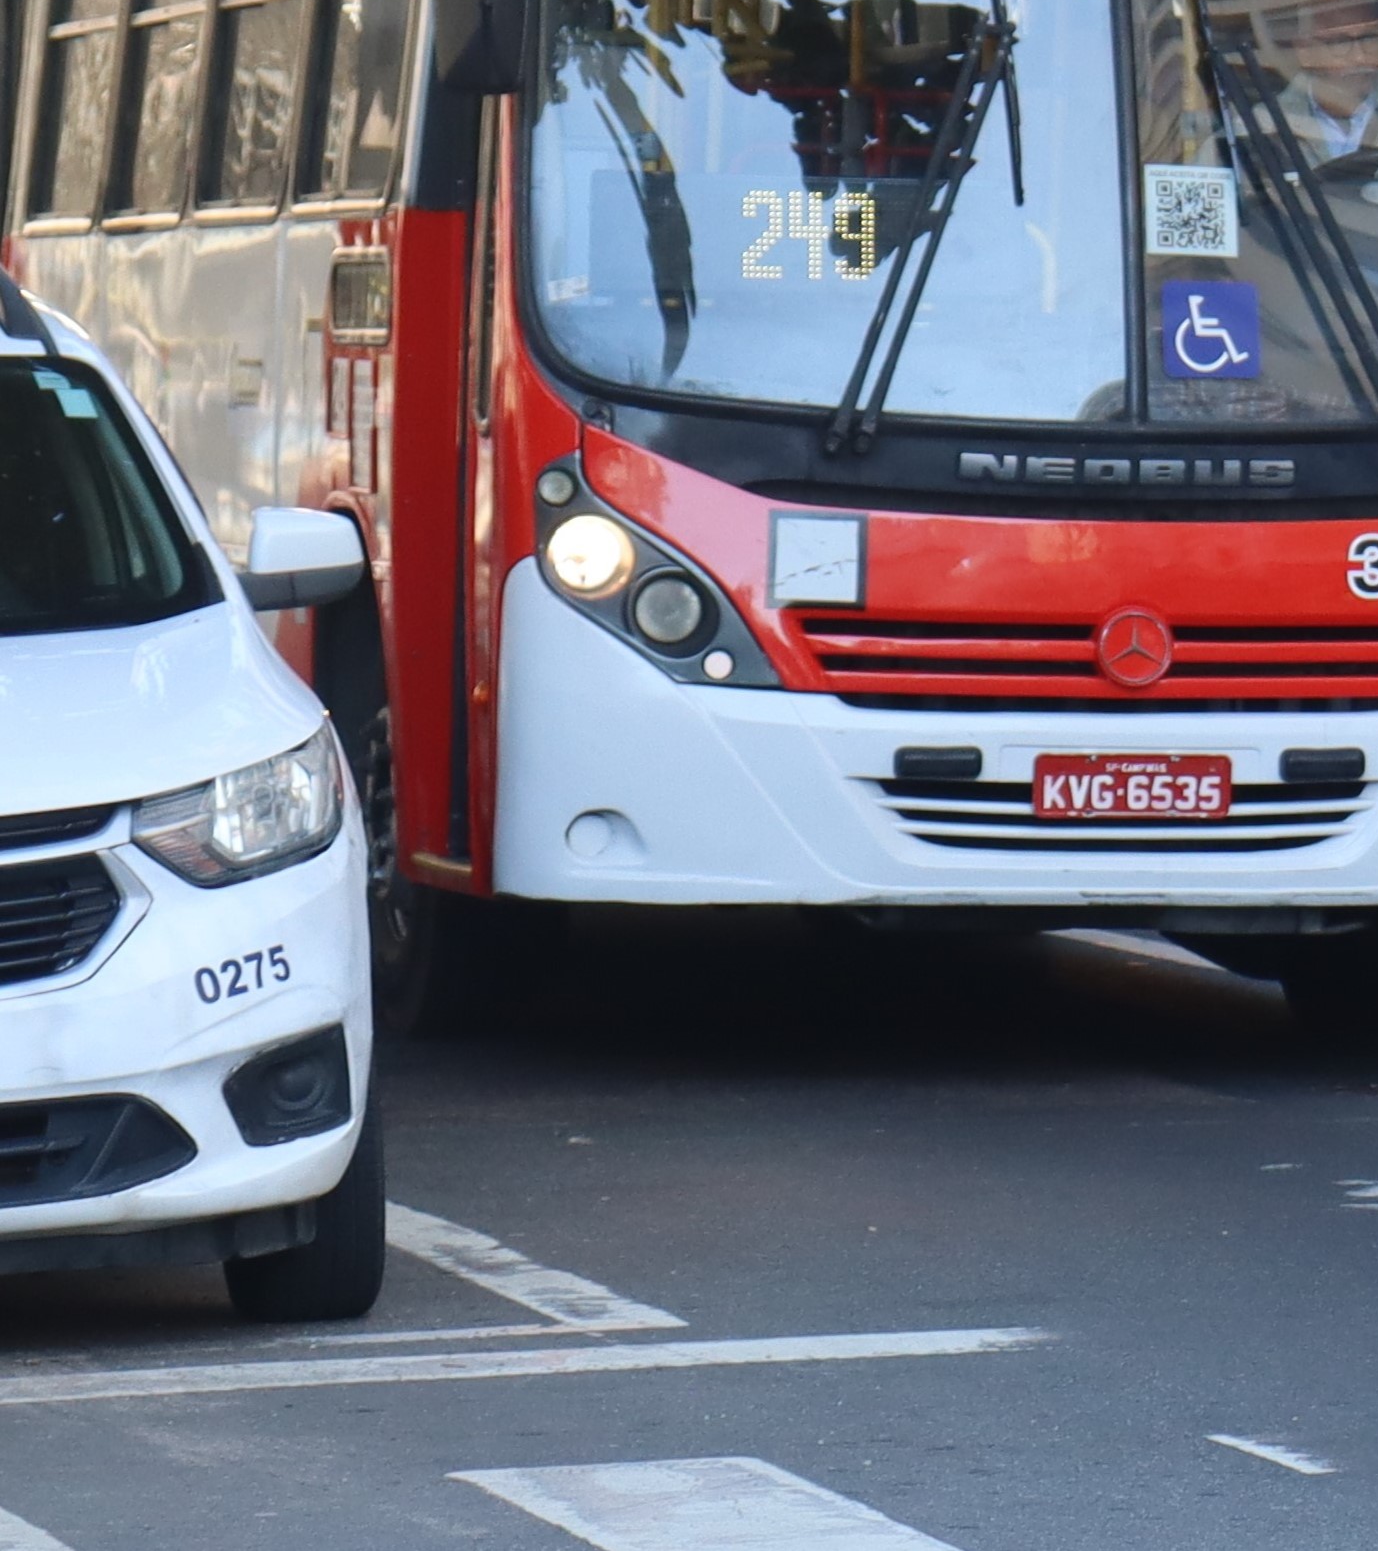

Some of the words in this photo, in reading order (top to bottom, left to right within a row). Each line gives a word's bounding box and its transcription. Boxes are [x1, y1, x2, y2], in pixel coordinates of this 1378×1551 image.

[741, 189, 876, 281] 249
[958, 452, 1296, 487] NEOBUS
[194, 944, 290, 1004] 0275
